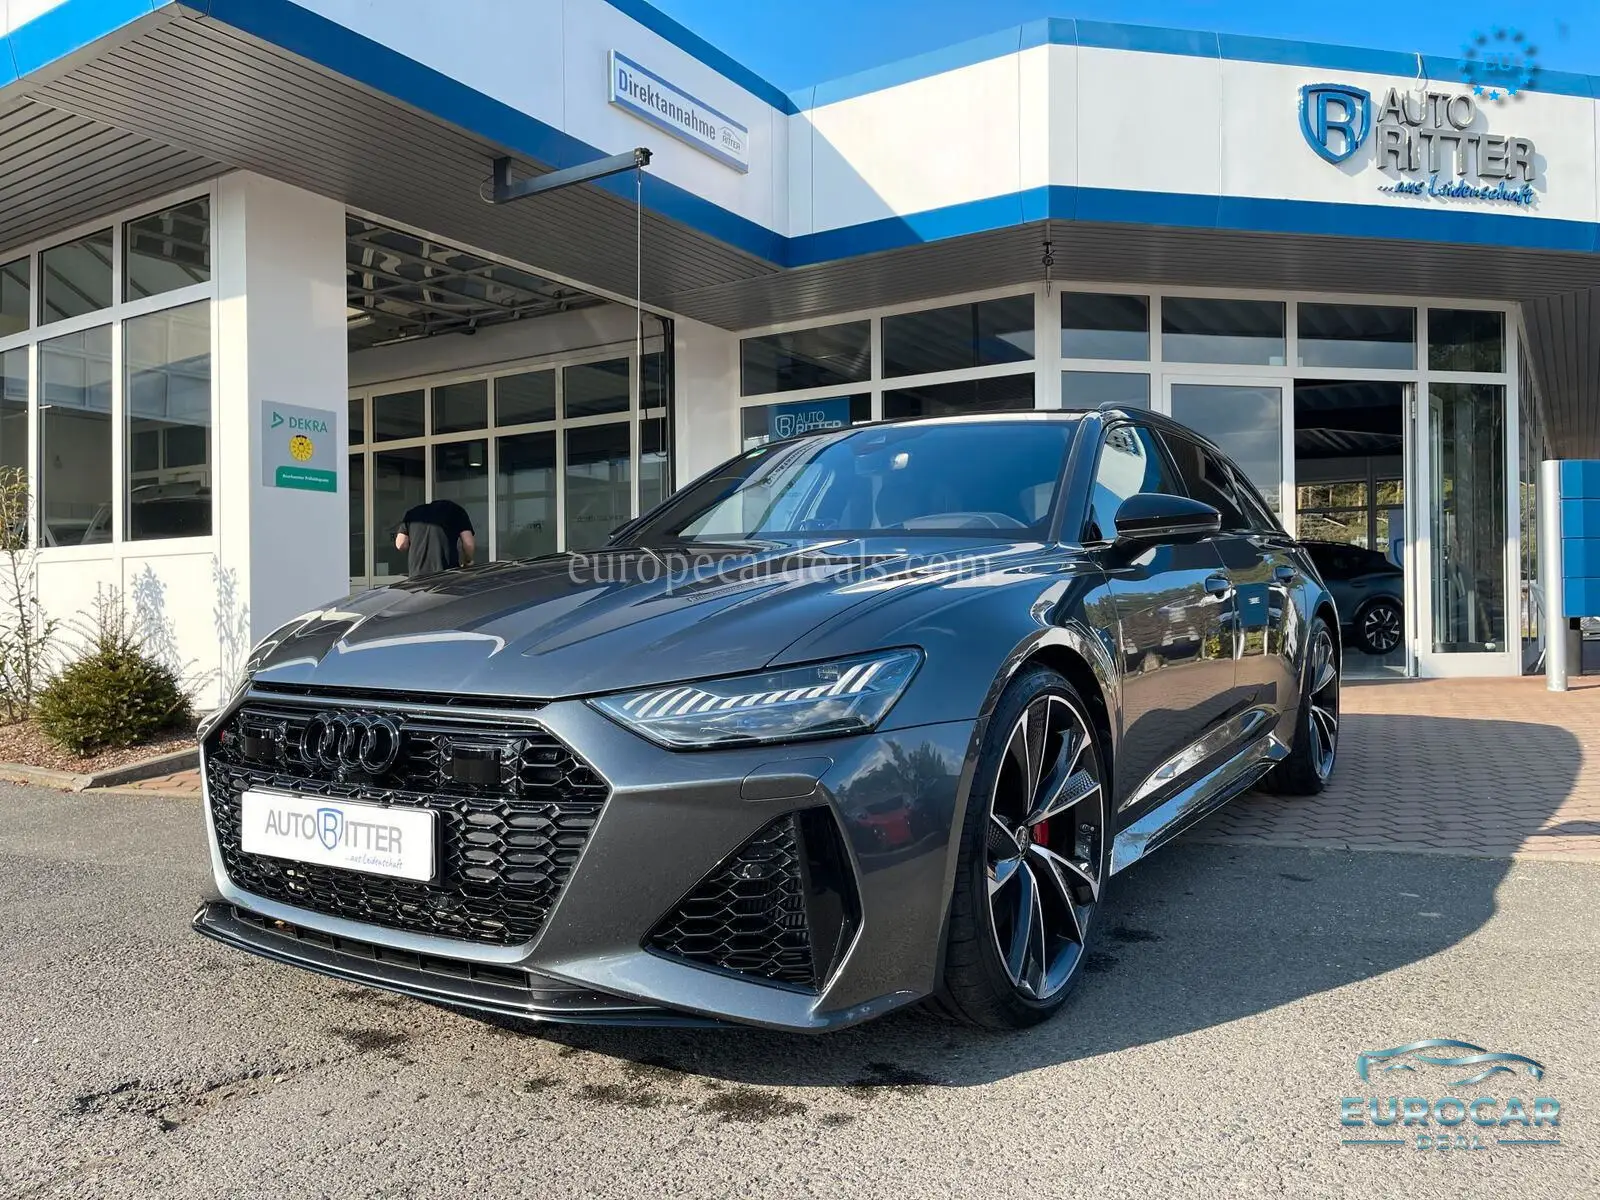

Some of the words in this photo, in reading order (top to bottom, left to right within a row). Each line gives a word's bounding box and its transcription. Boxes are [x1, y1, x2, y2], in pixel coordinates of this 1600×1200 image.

[618, 68, 716, 140] Direktannahme
[1377, 87, 1477, 130] AUTO
[1376, 124, 1536, 181] RITTER
[1428, 174, 1535, 205] Leidenschaft
[289, 416, 328, 433] DEKRA
[796, 410, 825, 424] AUTO
